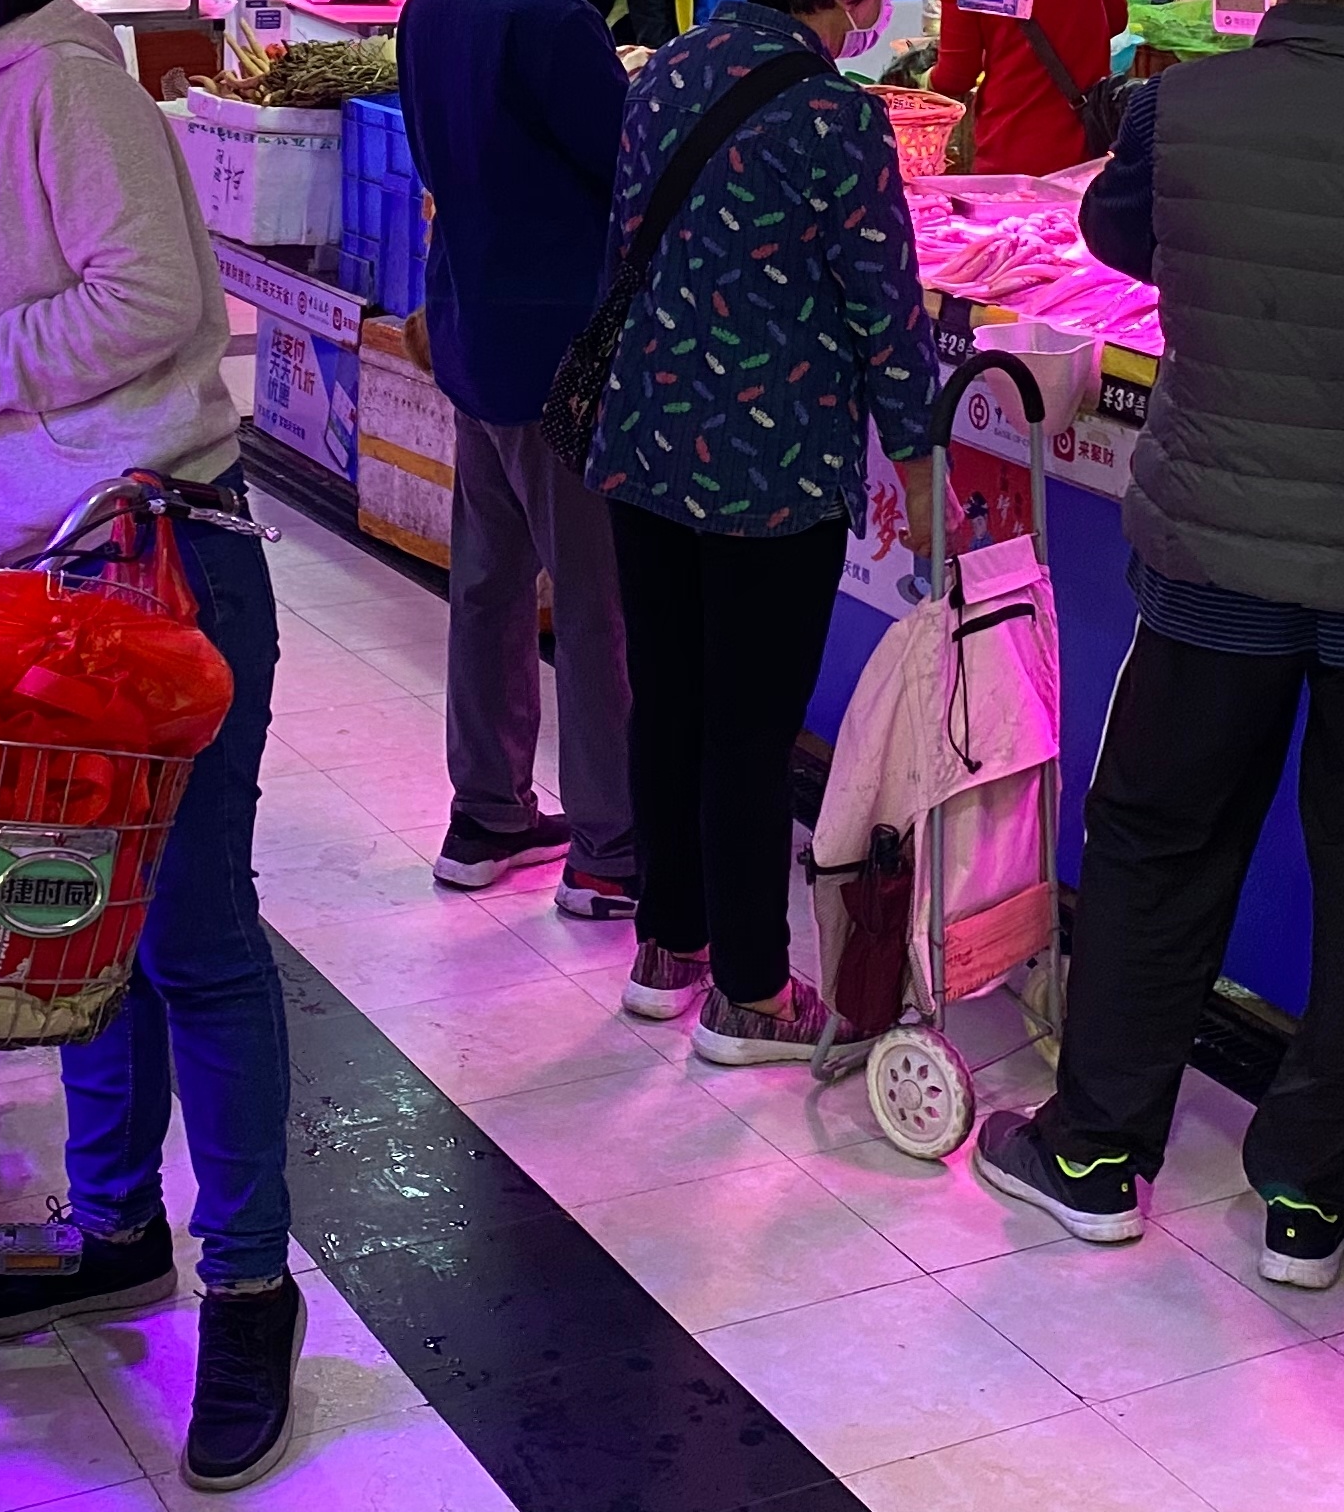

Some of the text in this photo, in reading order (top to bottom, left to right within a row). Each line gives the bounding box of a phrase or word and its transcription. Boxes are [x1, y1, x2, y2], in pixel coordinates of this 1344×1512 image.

[939, 331, 966, 355] ¥28
[1103, 385, 1135, 411] ¥33
[1078, 439, 1114, 468] 来聚财
[843, 559, 871, 584] 天优惠
